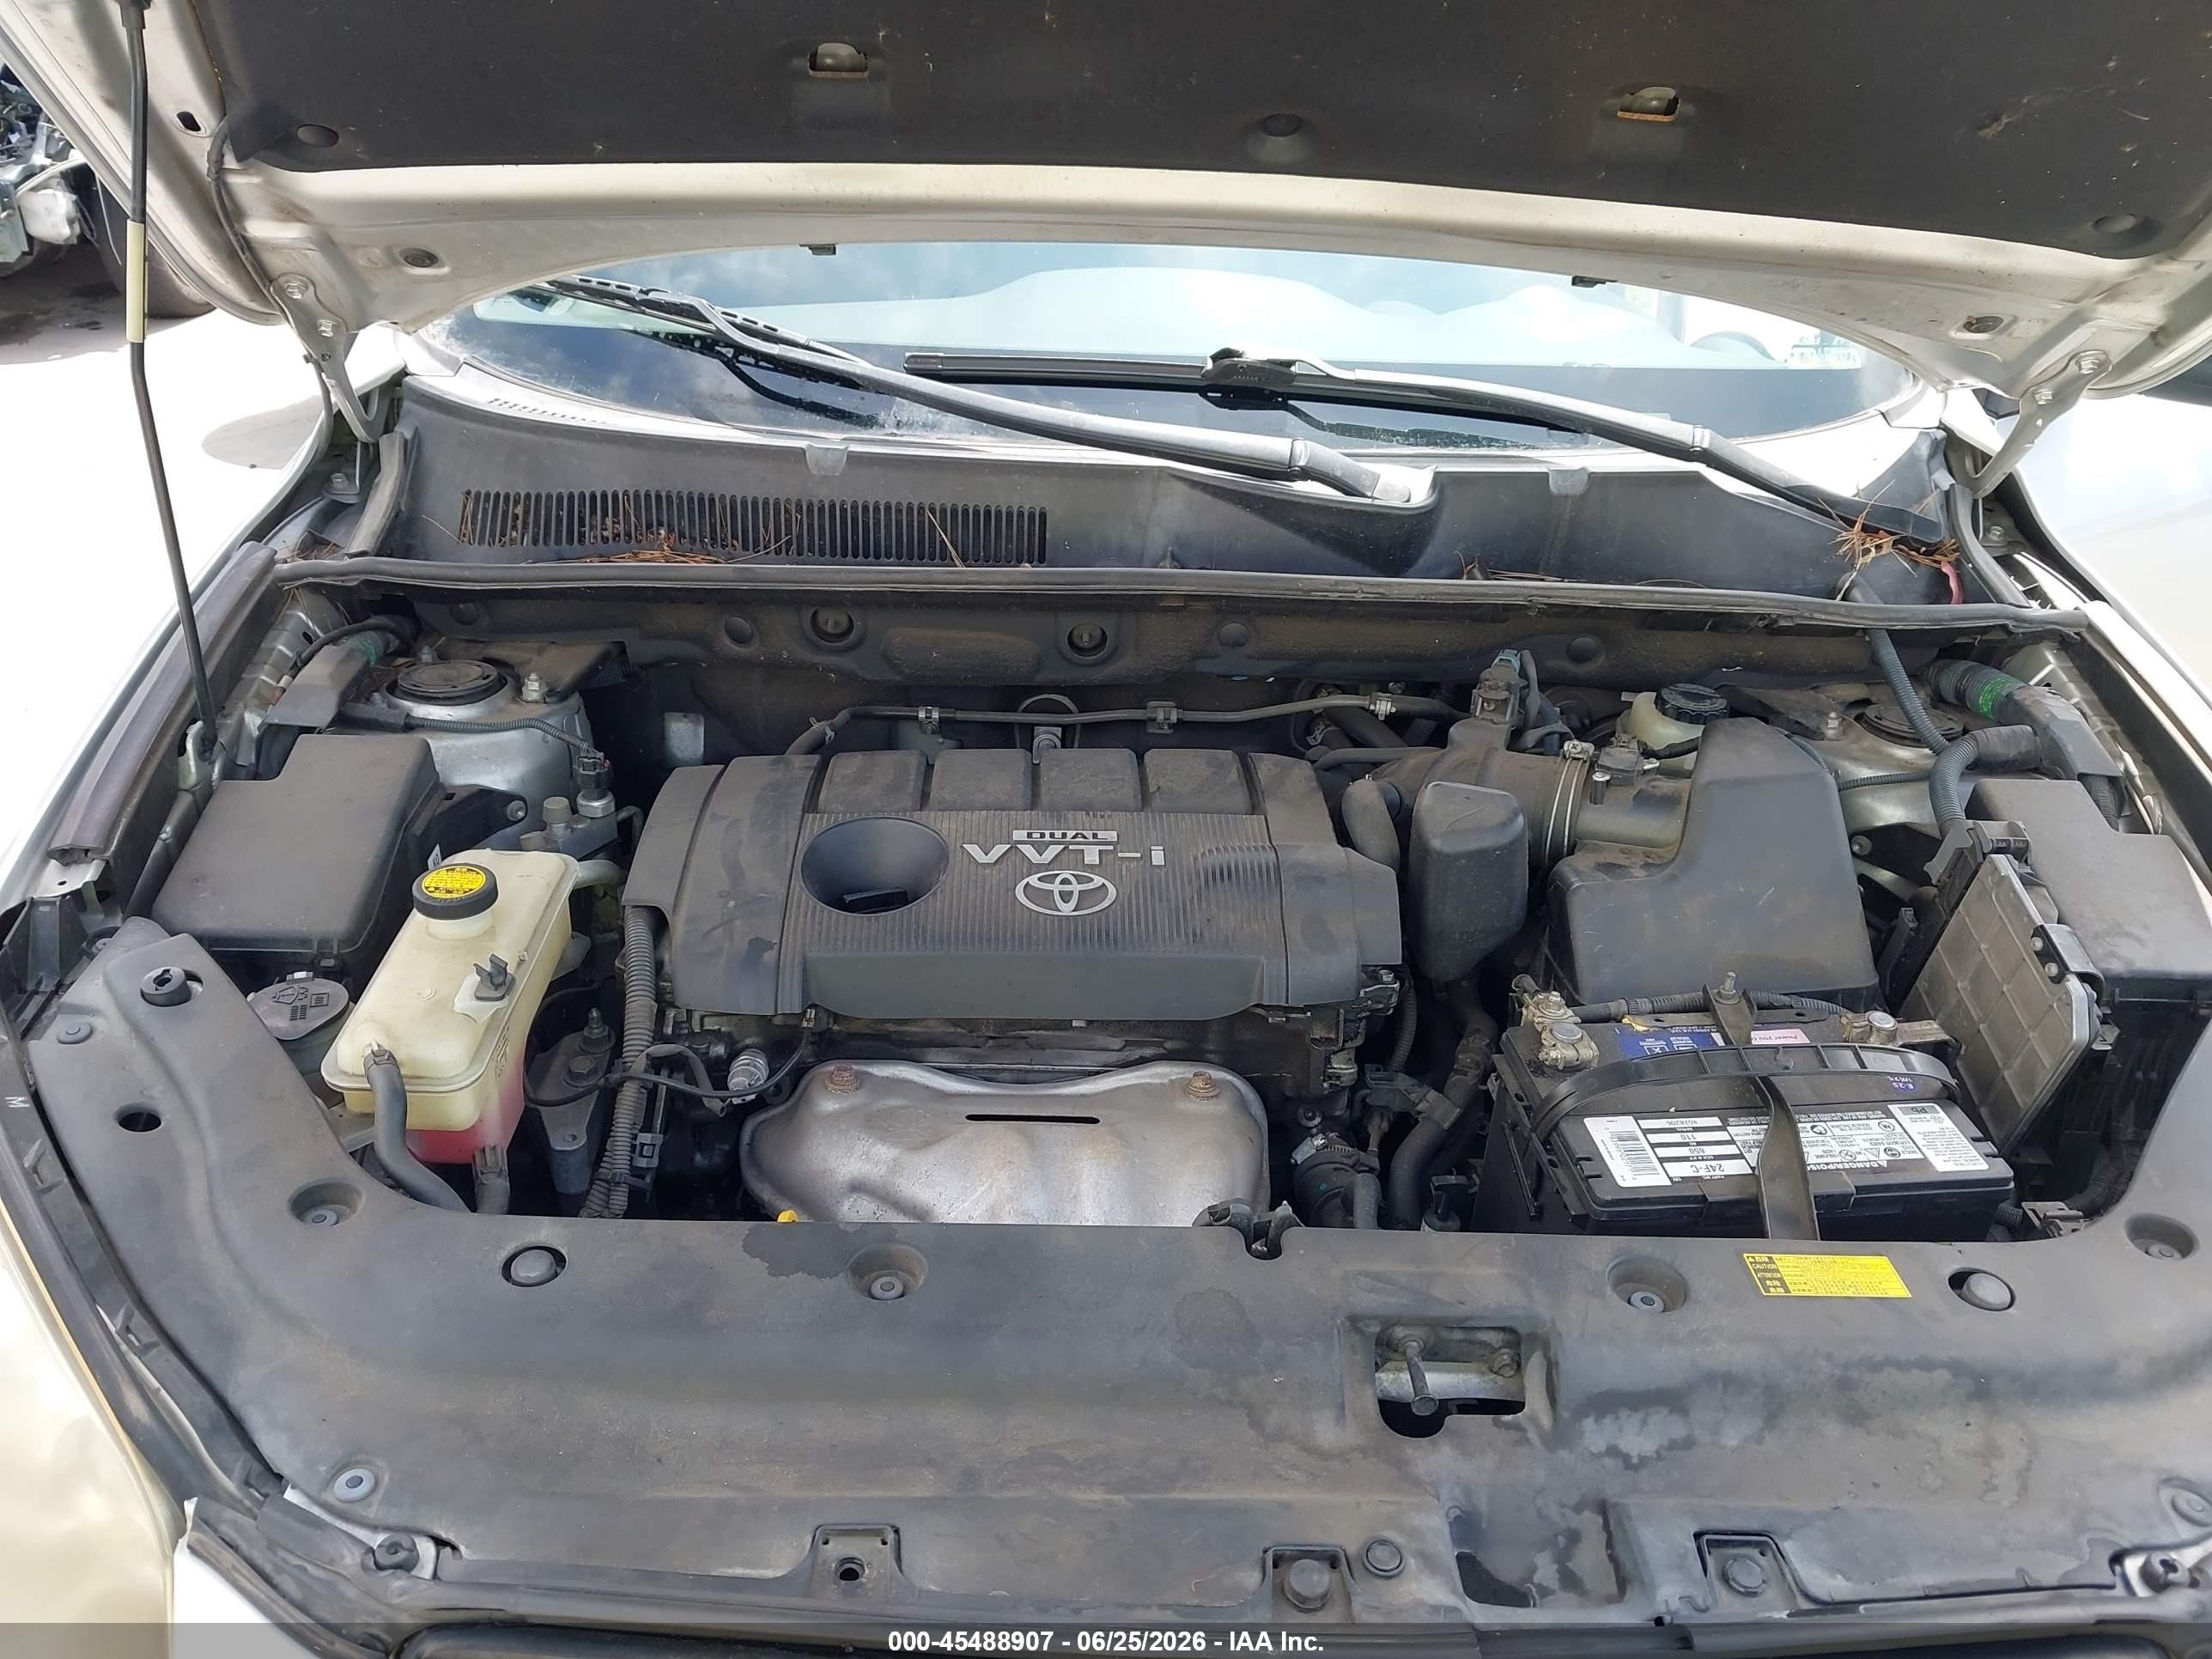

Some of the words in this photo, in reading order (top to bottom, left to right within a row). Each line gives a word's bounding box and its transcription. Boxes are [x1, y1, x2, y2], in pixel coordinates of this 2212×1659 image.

[1026, 831, 1109, 840] DUAL
[962, 844, 1165, 866] VVT-i
[1690, 1164, 1725, 1173] 24F-C
